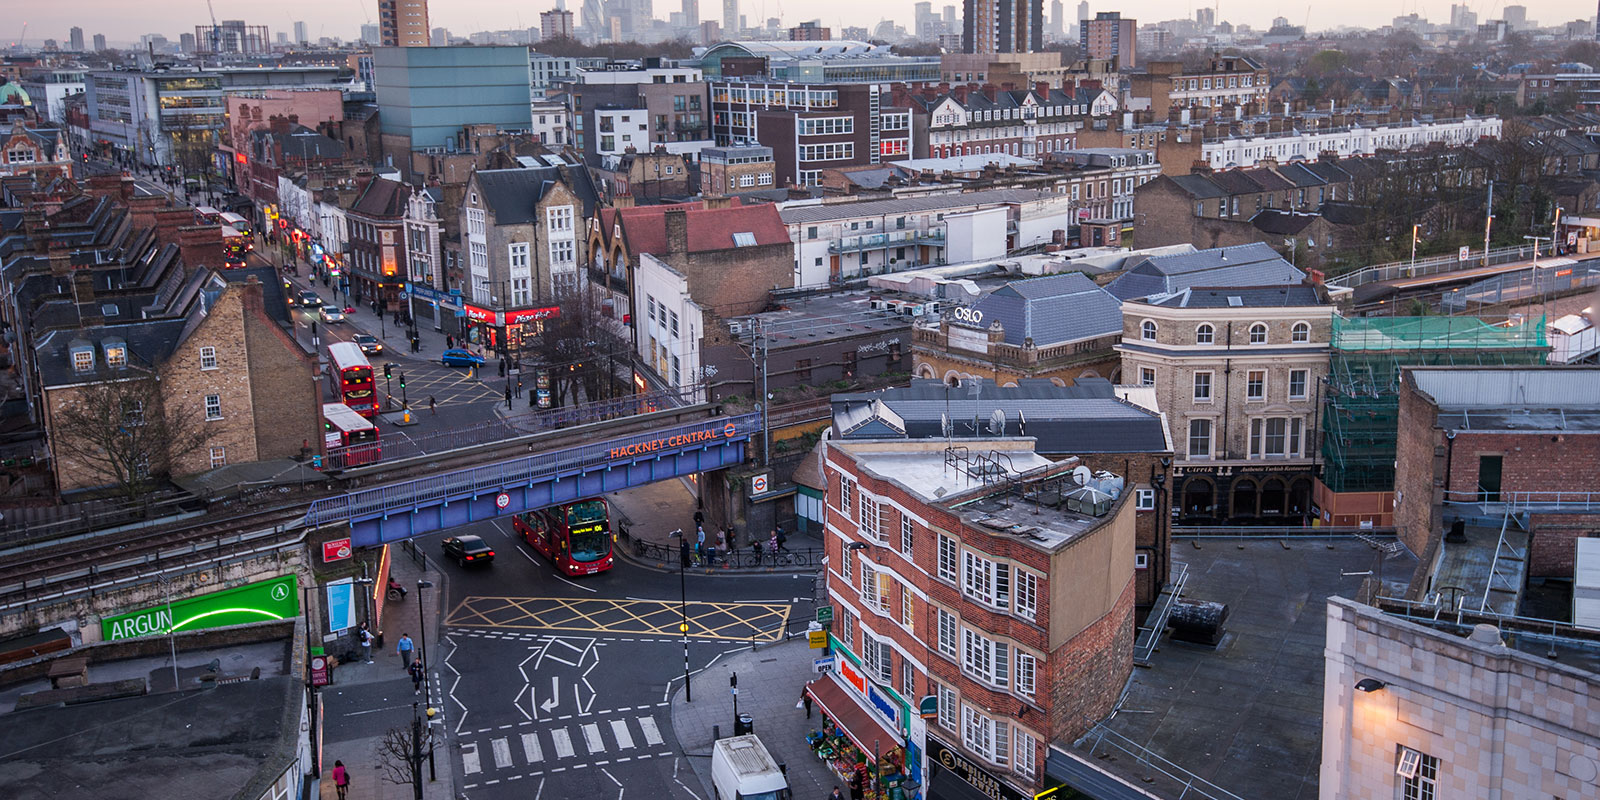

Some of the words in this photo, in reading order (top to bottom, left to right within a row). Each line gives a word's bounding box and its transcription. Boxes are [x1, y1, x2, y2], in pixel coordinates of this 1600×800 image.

[514, 314, 534, 324] Pizza
[534, 310, 551, 320] Hut
[955, 307, 983, 323] OSLO
[611, 439, 665, 459] HACKNEY
[668, 429, 717, 447] CENTRAL
[111, 608, 172, 640] ARGUN
[818, 664, 832, 672] OPEN
